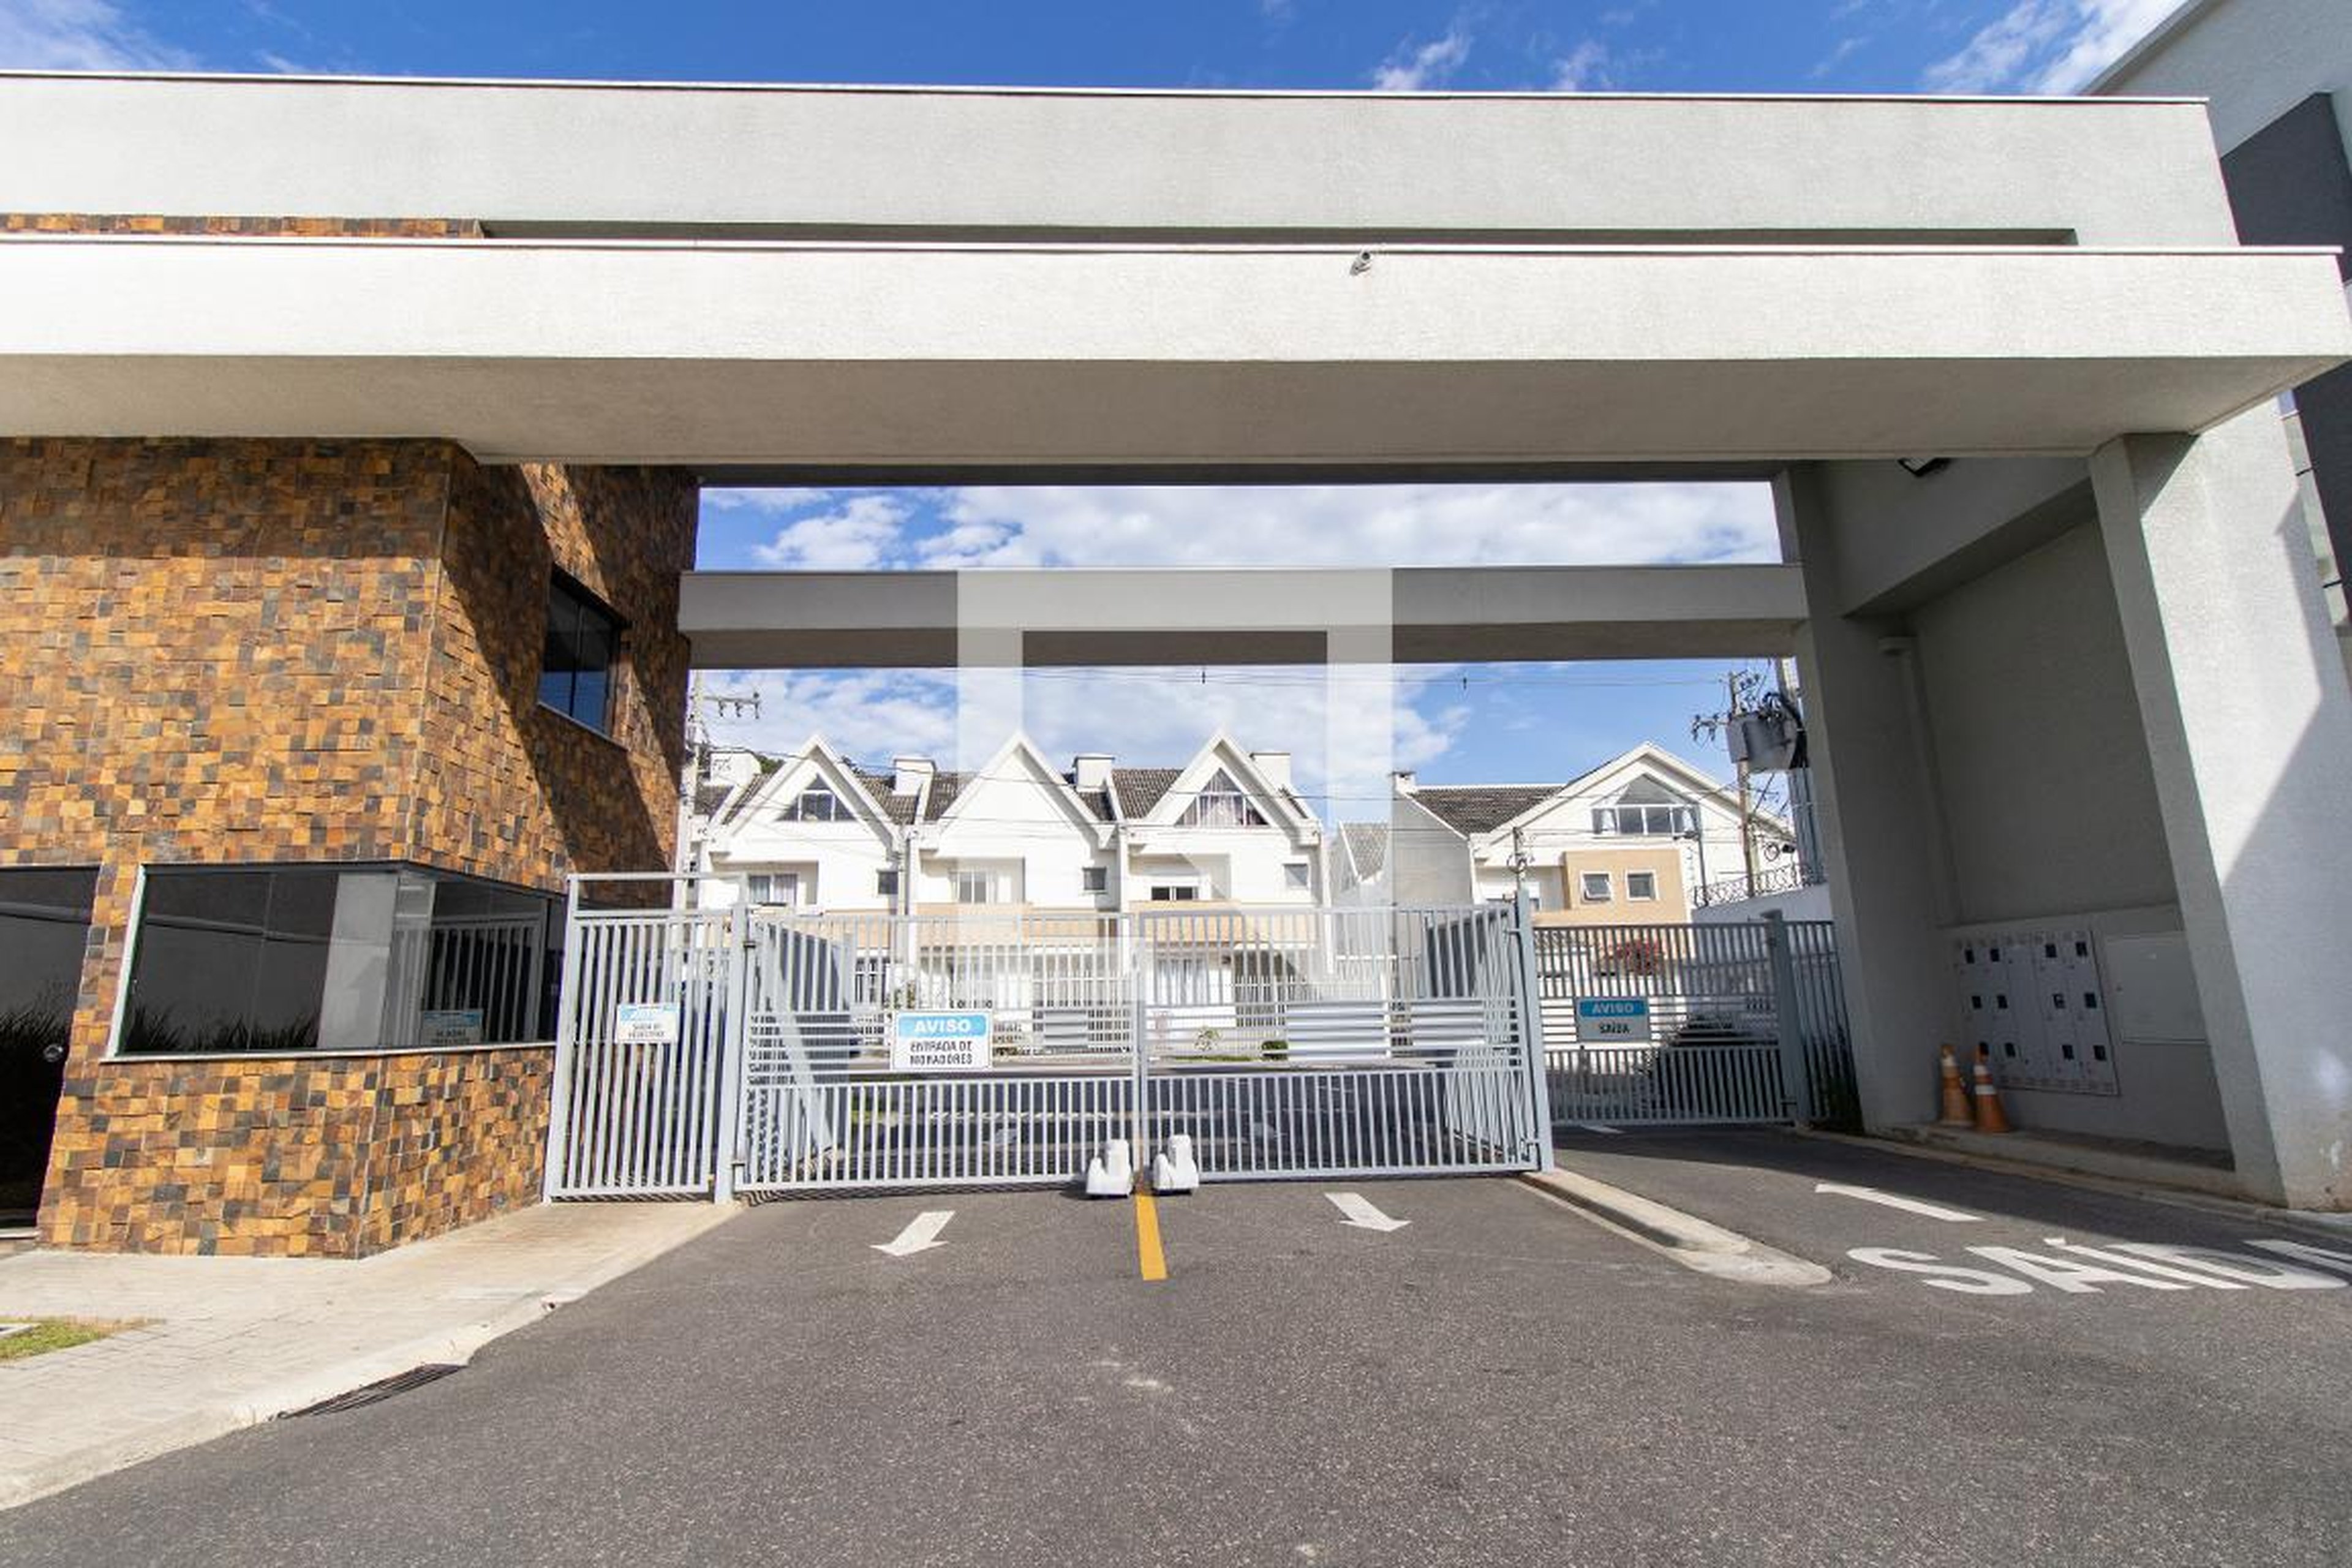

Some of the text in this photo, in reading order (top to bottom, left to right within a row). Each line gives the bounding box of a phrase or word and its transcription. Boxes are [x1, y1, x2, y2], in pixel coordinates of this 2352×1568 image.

[1592, 1003, 1634, 1014] AVISO
[914, 1018, 972, 1034] AVISO
[910, 1041, 973, 1052] ENTRADA DE
[910, 1054, 973, 1065] MORADORES
